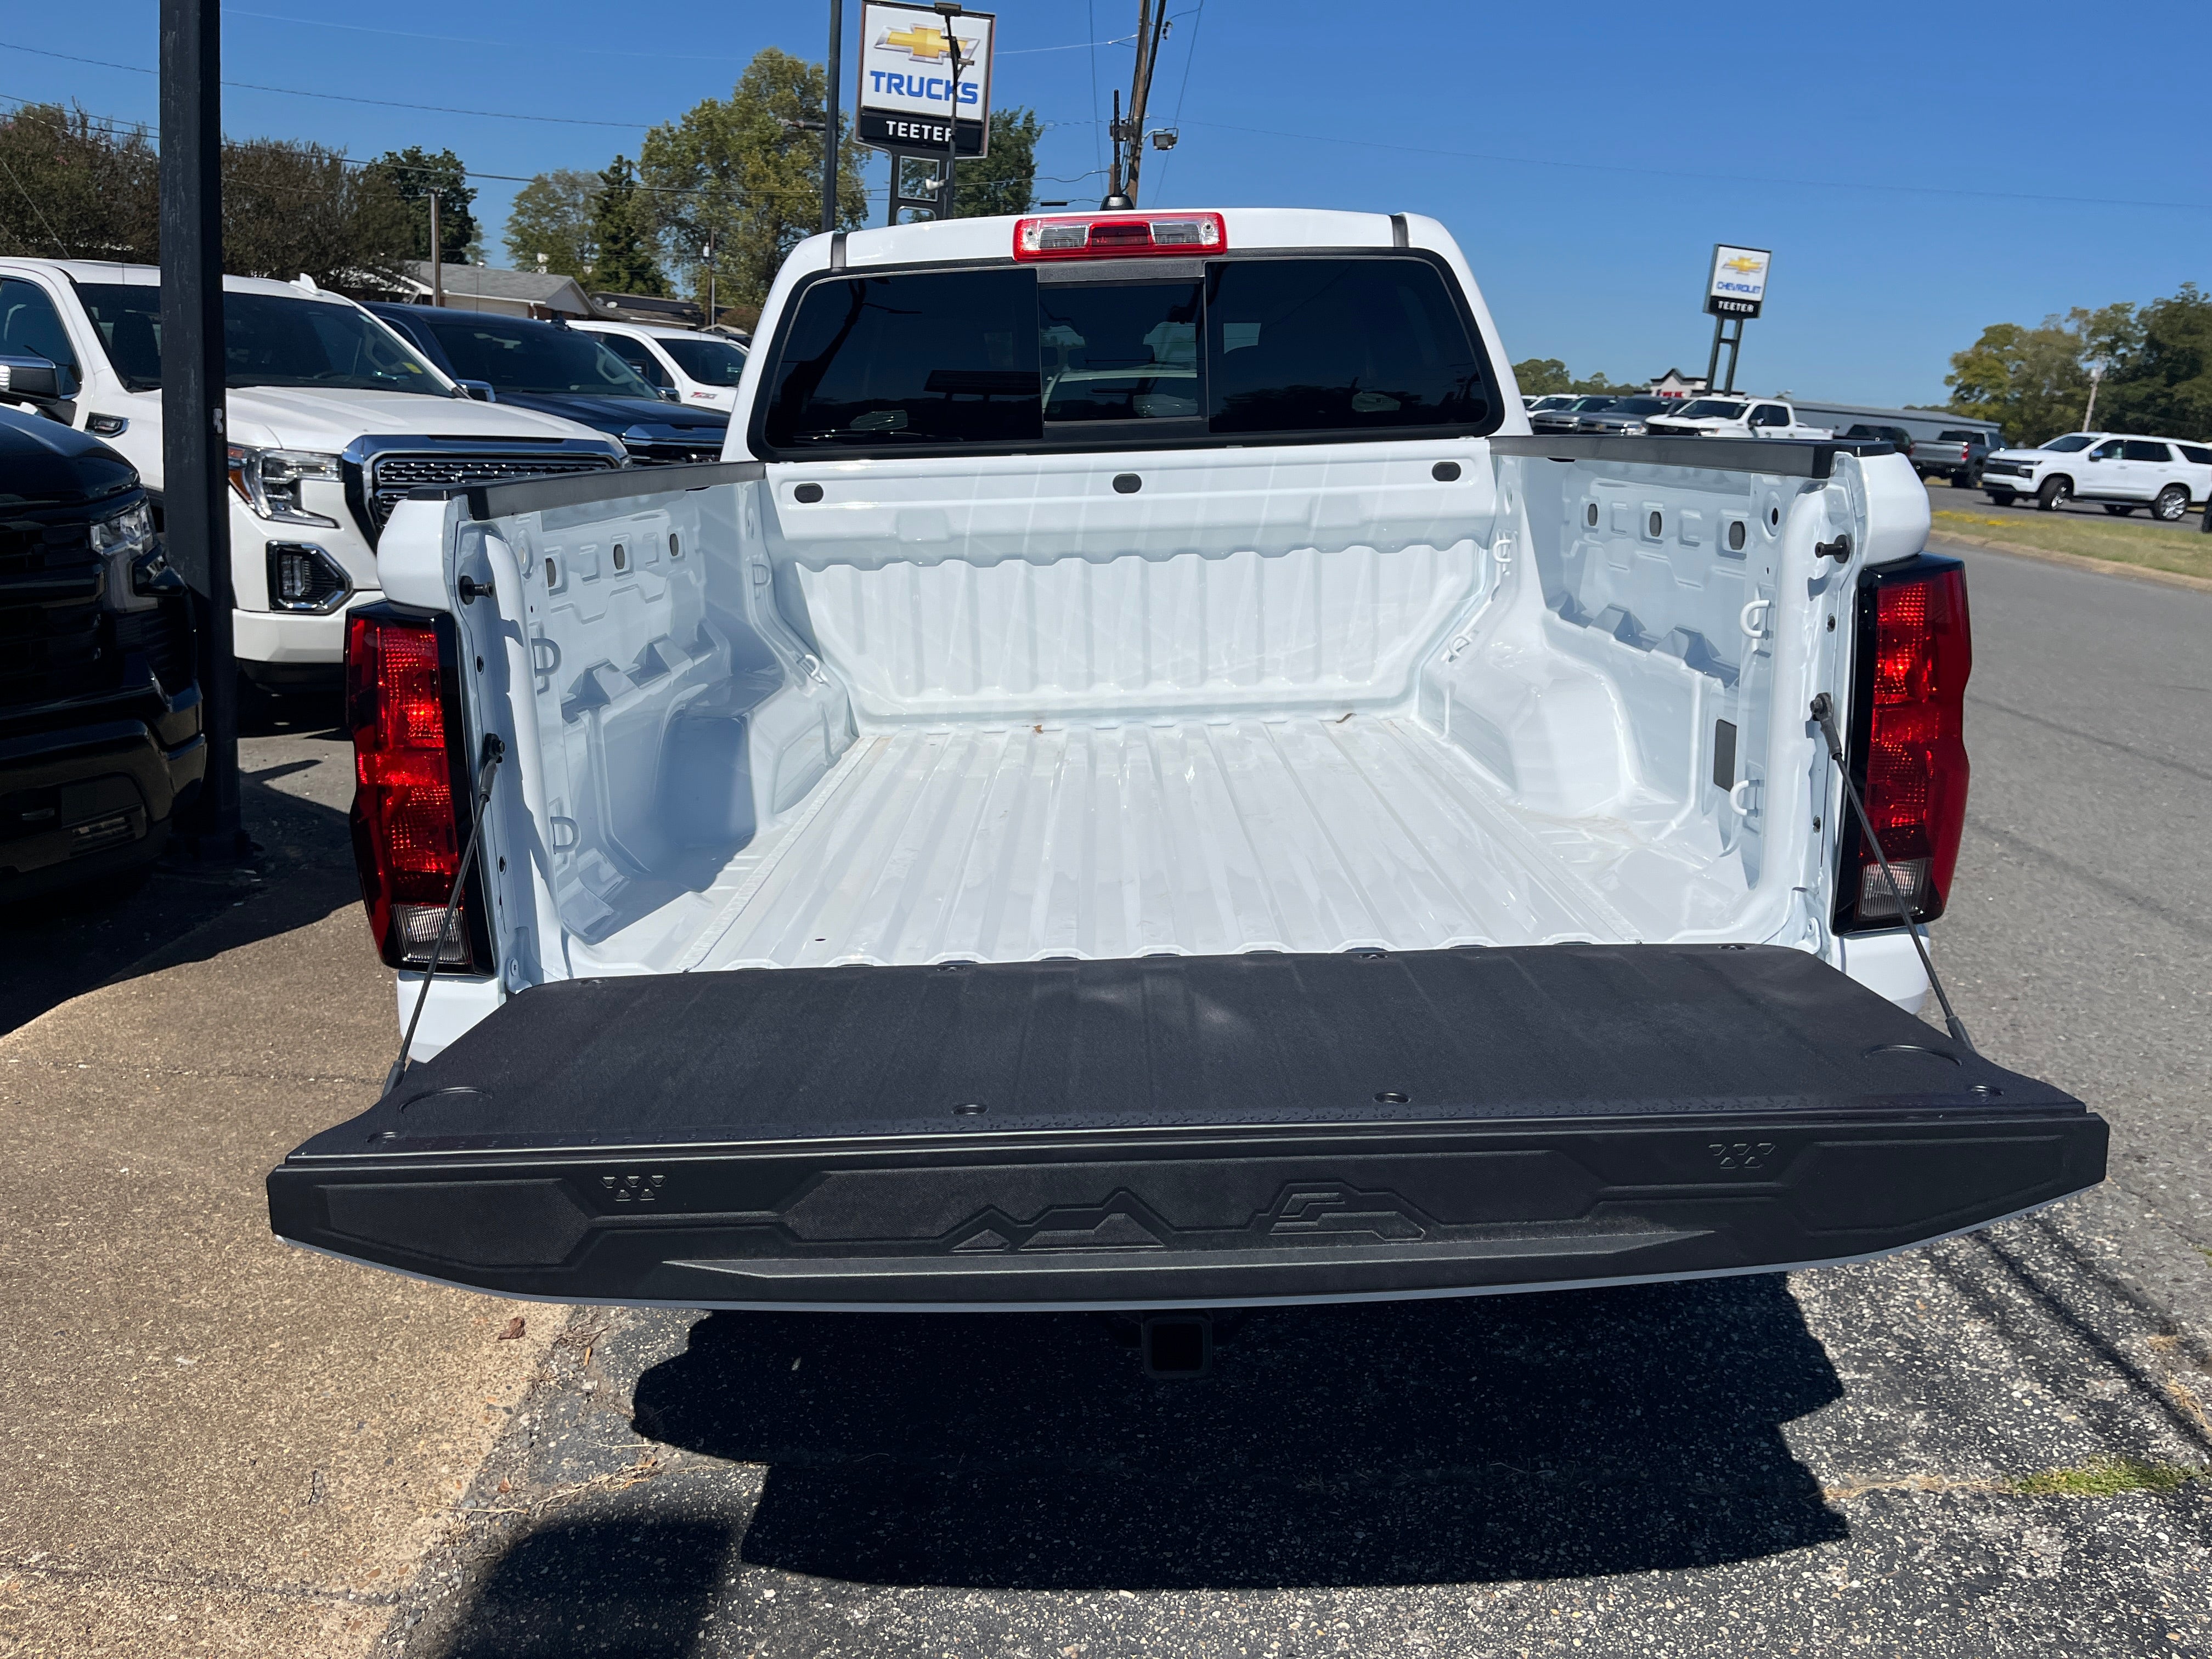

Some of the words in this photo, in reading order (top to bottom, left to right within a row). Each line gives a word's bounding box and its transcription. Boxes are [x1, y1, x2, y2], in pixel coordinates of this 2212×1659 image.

[870, 70, 978, 104] TRUCKS
[1716, 281, 1761, 294] CHEVROLET
[1718, 300, 1754, 313] TEETER
